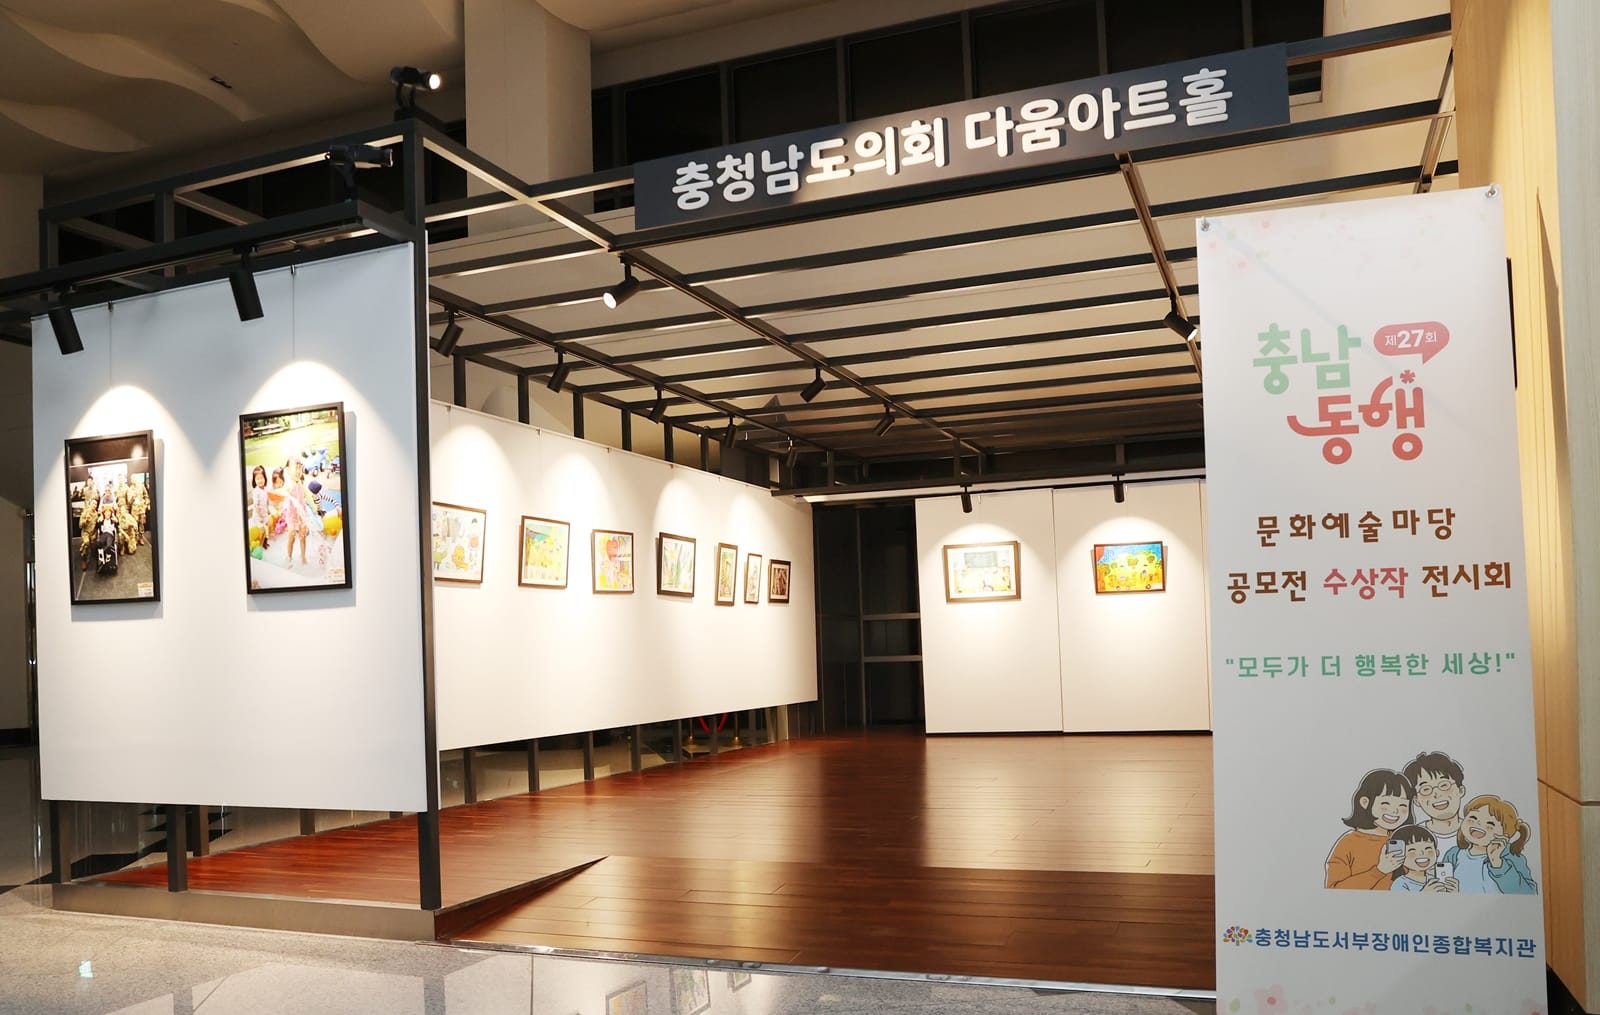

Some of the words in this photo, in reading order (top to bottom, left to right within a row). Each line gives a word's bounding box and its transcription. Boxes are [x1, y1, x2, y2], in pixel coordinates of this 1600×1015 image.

[672, 119, 948, 212] 충청남도의회
[965, 67, 1234, 158] 다움아트홀
[1252, 322, 1362, 395] 충남
[1384, 329, 1438, 349] 제27회
[1287, 369, 1426, 465] 동행
[1256, 507, 1457, 547] 문화예술마당
[1226, 571, 1307, 605] 공모전
[1323, 567, 1409, 600] 수상작
[1421, 561, 1512, 598] 전시회
[1320, 655, 1342, 678] 더
[1354, 653, 1429, 678] 행복한
[1254, 927, 1537, 957] 충청남도서부장애인종합복지관
